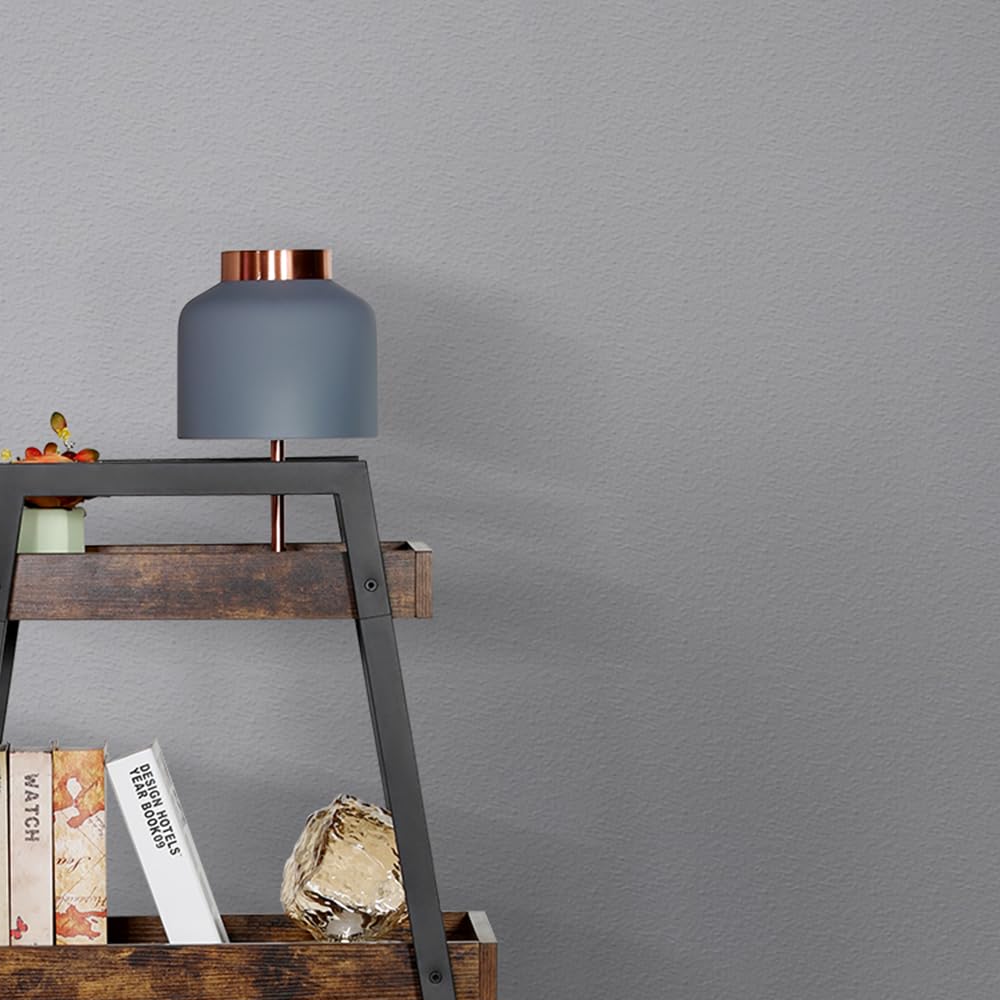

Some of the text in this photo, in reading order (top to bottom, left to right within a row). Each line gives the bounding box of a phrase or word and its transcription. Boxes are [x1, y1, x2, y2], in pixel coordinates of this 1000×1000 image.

[24, 773, 40, 842] WATCH
[129, 767, 166, 849] YEAR BOOK09
[140, 763, 181, 856] DESIGN HOTELS
